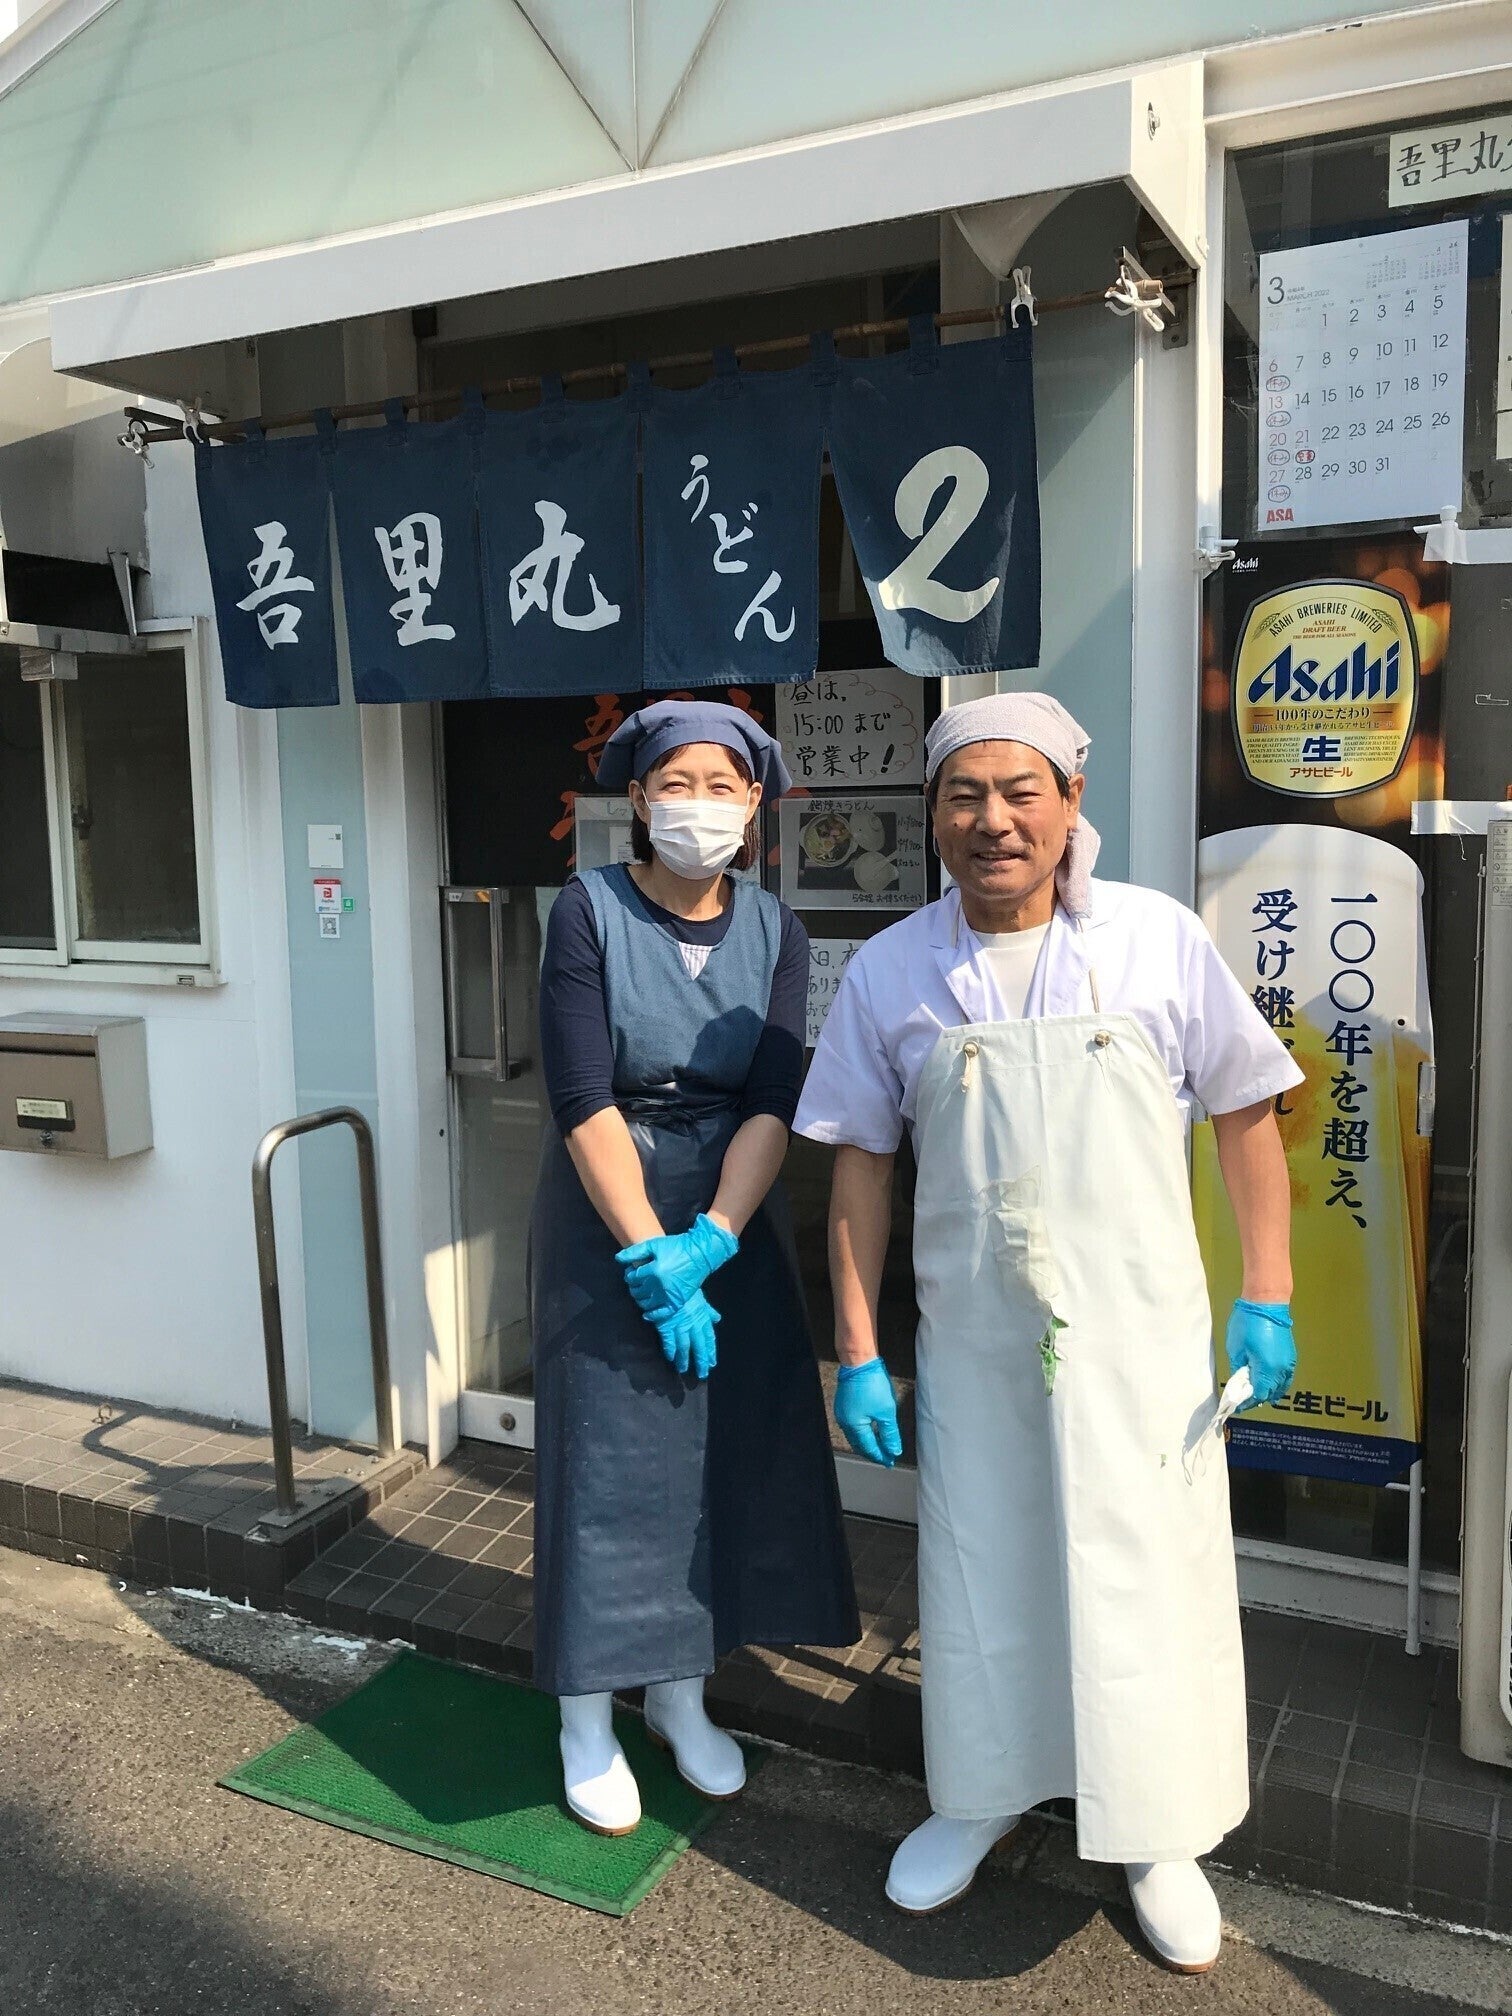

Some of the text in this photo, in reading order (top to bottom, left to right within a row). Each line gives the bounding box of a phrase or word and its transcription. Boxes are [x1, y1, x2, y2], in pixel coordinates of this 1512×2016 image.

[1267, 276, 1285, 305] 3
[1322, 314, 1327, 326] 1
[1350, 309, 1359, 323] 2
[1377, 305, 1386, 318] 3
[1405, 300, 1415, 313] 4
[1433, 295, 1443, 309] 5
[1269, 333, 1449, 373] 6 7 8 9 10 11 12
[1269, 373, 1448, 410] 13 14 15 16 17 18 19
[1269, 411, 1450, 447] 20 21 22 23 24 25 26
[1269, 470, 1285, 484] 27
[1295, 466, 1312, 481] 28
[1321, 463, 1339, 478] 29
[1348, 460, 1367, 474] 30
[1376, 457, 1390, 471] 31
[1266, 508, 1294, 524] ASA
[681, 454, 797, 644] うどん
[878, 446, 1001, 622] 2
[235, 500, 621, 651] 吾里丸
[1232, 557, 1259, 570] Asahi
[1269, 602, 1383, 637] ASAHI BREWERIES LIMITED
[1248, 640, 1400, 705] Asahi
[794, 711, 892, 737] 15:00 まで
[1276, 707, 1370, 721] 100年のこだわり
[796, 743, 896, 778] 営業中!
[1302, 736, 1341, 763] 生
[1289, 766, 1353, 778] アサヒビール
